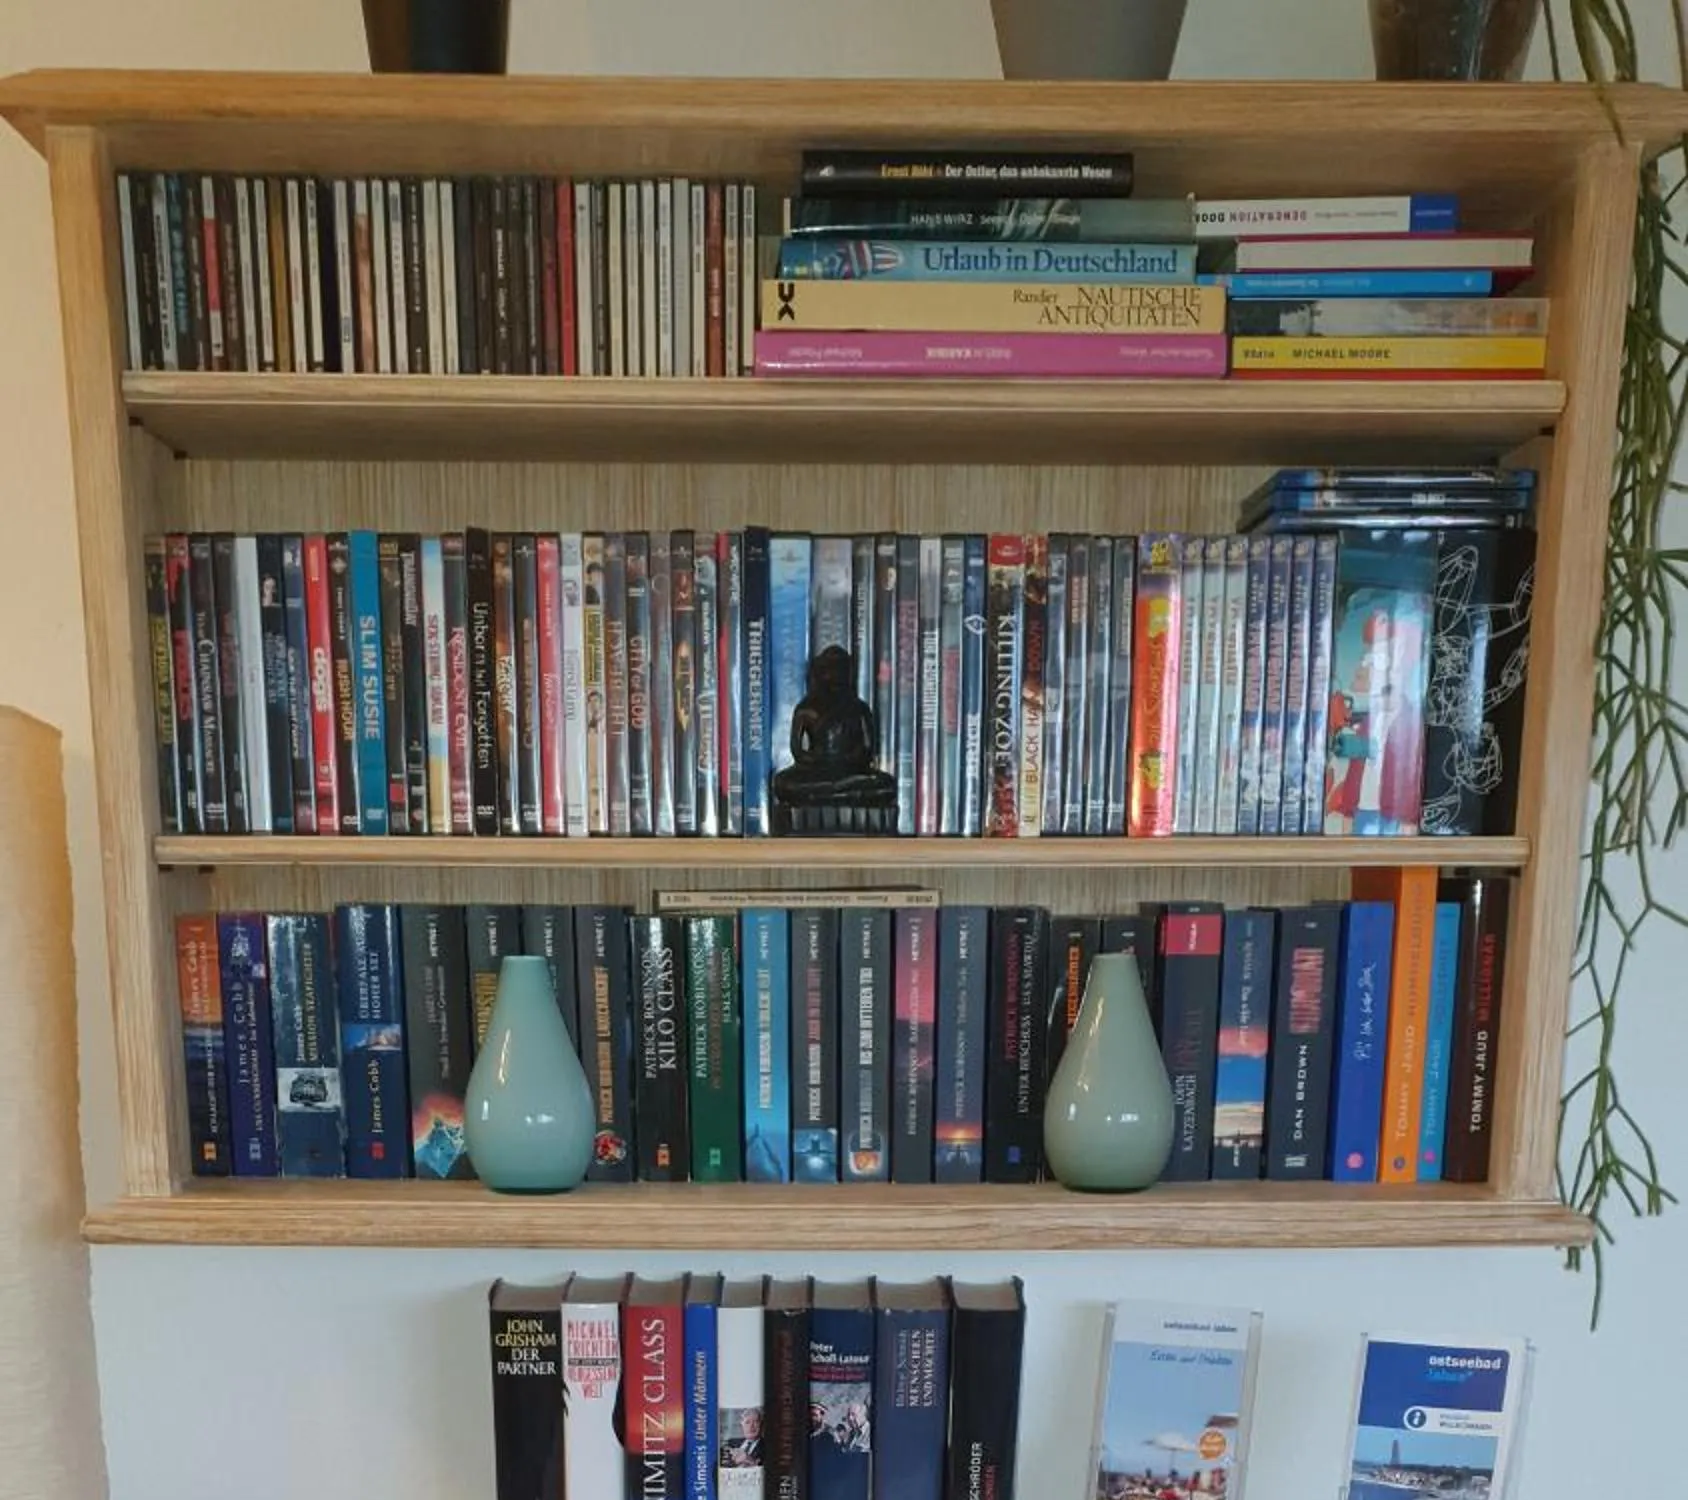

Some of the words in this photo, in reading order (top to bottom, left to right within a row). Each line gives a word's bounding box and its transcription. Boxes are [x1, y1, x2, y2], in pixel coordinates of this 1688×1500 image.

[922, 246, 1001, 272] Urlaub
[1004, 247, 1028, 271] in
[1032, 245, 1178, 274] Deutschland
[1077, 285, 1202, 307] NAUTISCHE
[1292, 348, 1345, 360] MICHAEL
[1347, 348, 1393, 360] MOORE
[359, 615, 379, 670] SLIM
[472, 602, 490, 666] Unborn
[629, 634, 645, 675] CITY
[336, 658, 350, 698] RUSH
[748, 617, 765, 752] TRIGGERMEN
[995, 613, 1015, 709] KILLING
[340, 700, 354, 741] HOUR
[362, 675, 382, 741] SUSIE
[473, 690, 492, 770] Forgotten
[631, 691, 647, 730] GOD
[1024, 734, 1040, 784] BLACK
[639, 948, 655, 1020] ROBINSON
[654, 947, 674, 1012] CLASS
[692, 950, 706, 1020] ROBINSON
[236, 1032, 250, 1085] James
[305, 1014, 319, 1062] MISSION
[643, 1022, 657, 1079] PATRICK
[658, 1018, 677, 1070] KILO
[695, 1023, 708, 1079] PATRICK
[1401, 1024, 1417, 1074] JAUD
[1474, 1029, 1490, 1071] JAUD
[366, 1059, 381, 1093] Cobb
[1018, 1073, 1031, 1113] UNTER
[1295, 1044, 1309, 1101] BROWN
[371, 1096, 385, 1134] James
[1292, 1108, 1305, 1141] DAN
[1396, 1081, 1411, 1139] TOMMY
[1425, 1088, 1438, 1137] TOMMY
[1468, 1074, 1485, 1134] TOMMY
[495, 1331, 557, 1347] GRISHAM
[506, 1318, 544, 1333] JOHN
[809, 1340, 833, 1353] Peter
[496, 1360, 557, 1376] PARTNER
[511, 1347, 540, 1361] DER
[640, 1317, 666, 1405] CLASS
[908, 1328, 921, 1407] MENSCHEN
[1428, 1354, 1503, 1370] ostseebad
[692, 1351, 708, 1406] Männern
[922, 1381, 935, 1407] UND
[694, 1408, 708, 1441] Unter
[693, 1445, 708, 1493] Simonis
